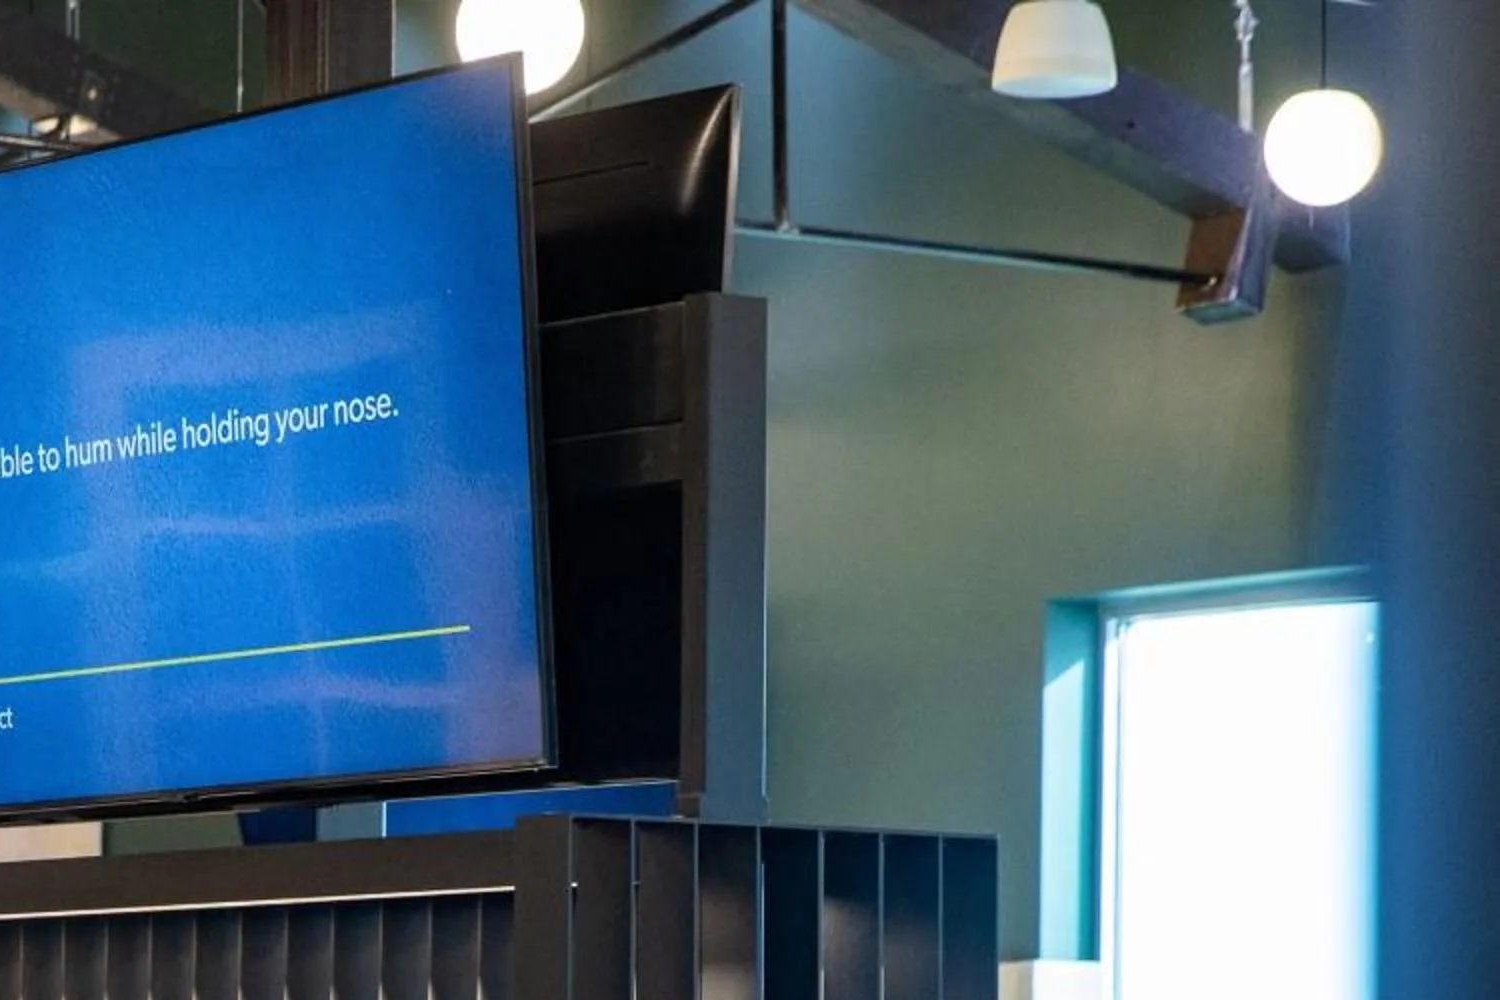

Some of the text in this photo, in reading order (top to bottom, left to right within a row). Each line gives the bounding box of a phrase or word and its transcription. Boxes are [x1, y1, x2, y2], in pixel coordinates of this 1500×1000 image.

[37, 442, 61, 473] to
[64, 435, 113, 469] hum
[116, 420, 177, 459] while
[181, 407, 270, 447] holding
[273, 402, 330, 443] your
[333, 392, 400, 425] nose.
